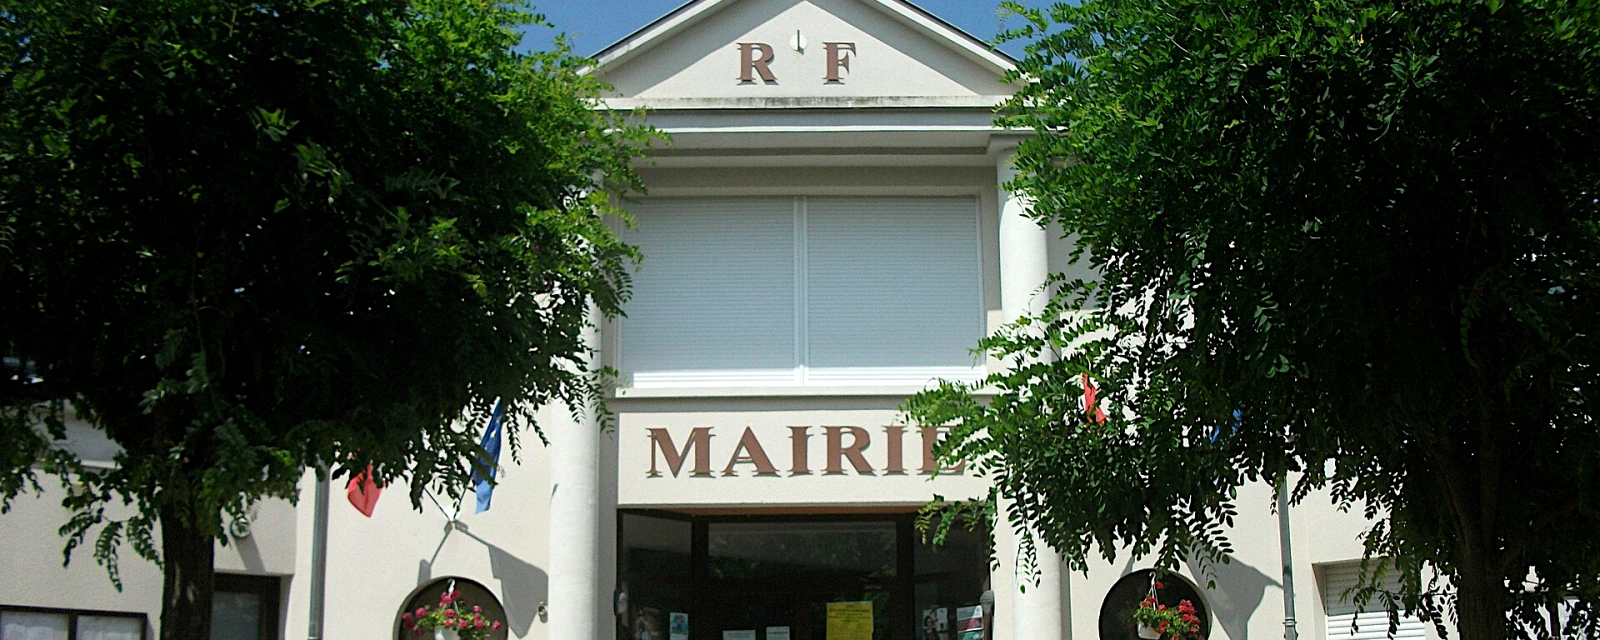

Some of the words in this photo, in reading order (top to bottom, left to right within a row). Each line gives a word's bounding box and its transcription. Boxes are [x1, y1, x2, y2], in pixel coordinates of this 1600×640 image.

[736, 42, 777, 82] R
[822, 41, 857, 82] F
[646, 425, 967, 477] MAIRIE
